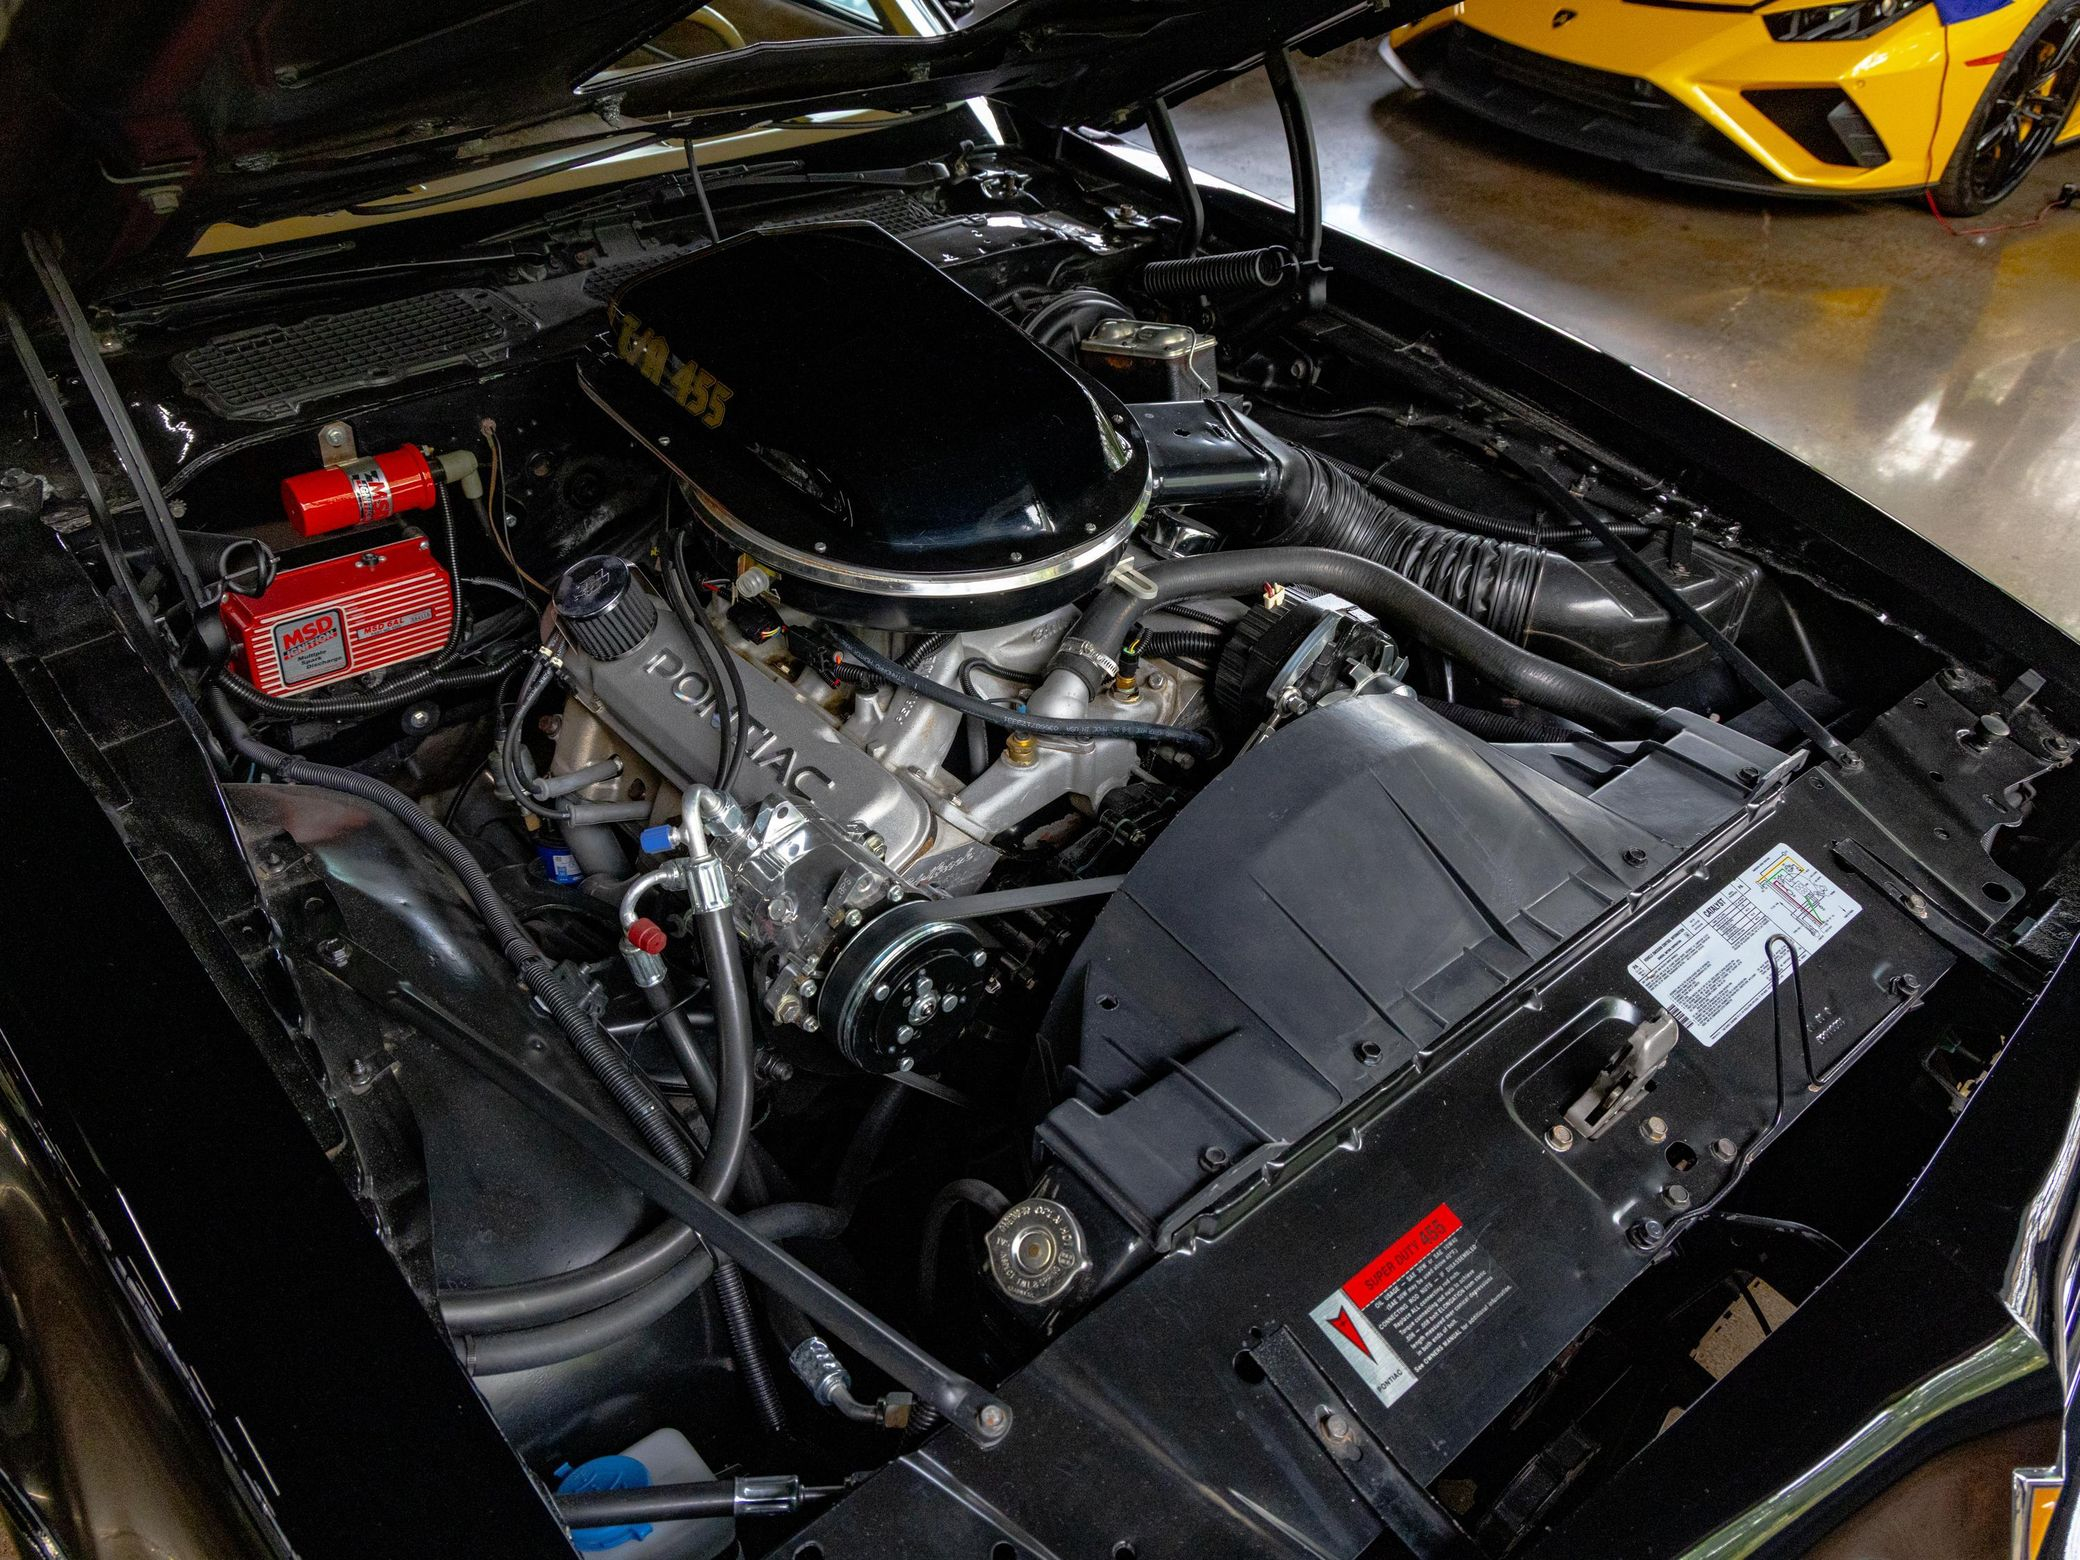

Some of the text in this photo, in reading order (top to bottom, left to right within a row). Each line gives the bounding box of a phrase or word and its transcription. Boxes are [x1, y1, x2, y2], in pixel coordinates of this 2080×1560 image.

[669, 359, 735, 430] 455
[368, 480, 391, 520] MS
[283, 615, 333, 651] MSD
[284, 628, 337, 660] IGNITION
[363, 623, 385, 635] MSD
[387, 618, 404, 629] 6AL
[297, 650, 327, 662] Multiple
[301, 656, 322, 665] Spark
[306, 656, 343, 669] Discharge
[1702, 897, 1727, 918] CATALYST
[1364, 1219, 1448, 1291] SUPER DUTY 455
[1421, 1267, 1435, 1280] used
[1373, 1299, 1384, 1309] OIL
[1383, 1285, 1400, 1301] USAGE
[1405, 1271, 1416, 1282] SAE
[1432, 1248, 1443, 1259] SAE
[1377, 1302, 1409, 1330] CONNECTING
[1407, 1292, 1420, 1304] ROD
[1418, 1281, 1433, 1295] NUTS
[1444, 1243, 1477, 1272] DISASSEMBLED
[1428, 1310, 1439, 1322] bolt
[1437, 1287, 1466, 1314] ELONGATION
[1463, 1278, 1475, 1290] from
[1472, 1268, 1487, 1282] static
[1392, 1311, 1412, 1330] Replace
[1409, 1304, 1421, 1315] ALL
[1418, 1284, 1444, 1308] connecting
[1440, 1277, 1451, 1288] rod
[1398, 1320, 1416, 1337] Torque
[1413, 1300, 1438, 1324] connecting
[1435, 1293, 1446, 1304] rod
[1443, 1285, 1456, 1297] nuts
[1457, 1267, 1476, 1285] achieve
[1409, 1274, 1494, 1351] length measured over conical depressions
[1413, 1361, 1425, 1373] See
[1422, 1343, 1445, 1365] OWNERS
[1441, 1327, 1462, 1348] MANUAL
[1466, 1303, 1489, 1325] additional
[1421, 1340, 1433, 1352] both
[1431, 1330, 1444, 1343] ends
[1376, 1368, 1403, 1394] PONTIAC
